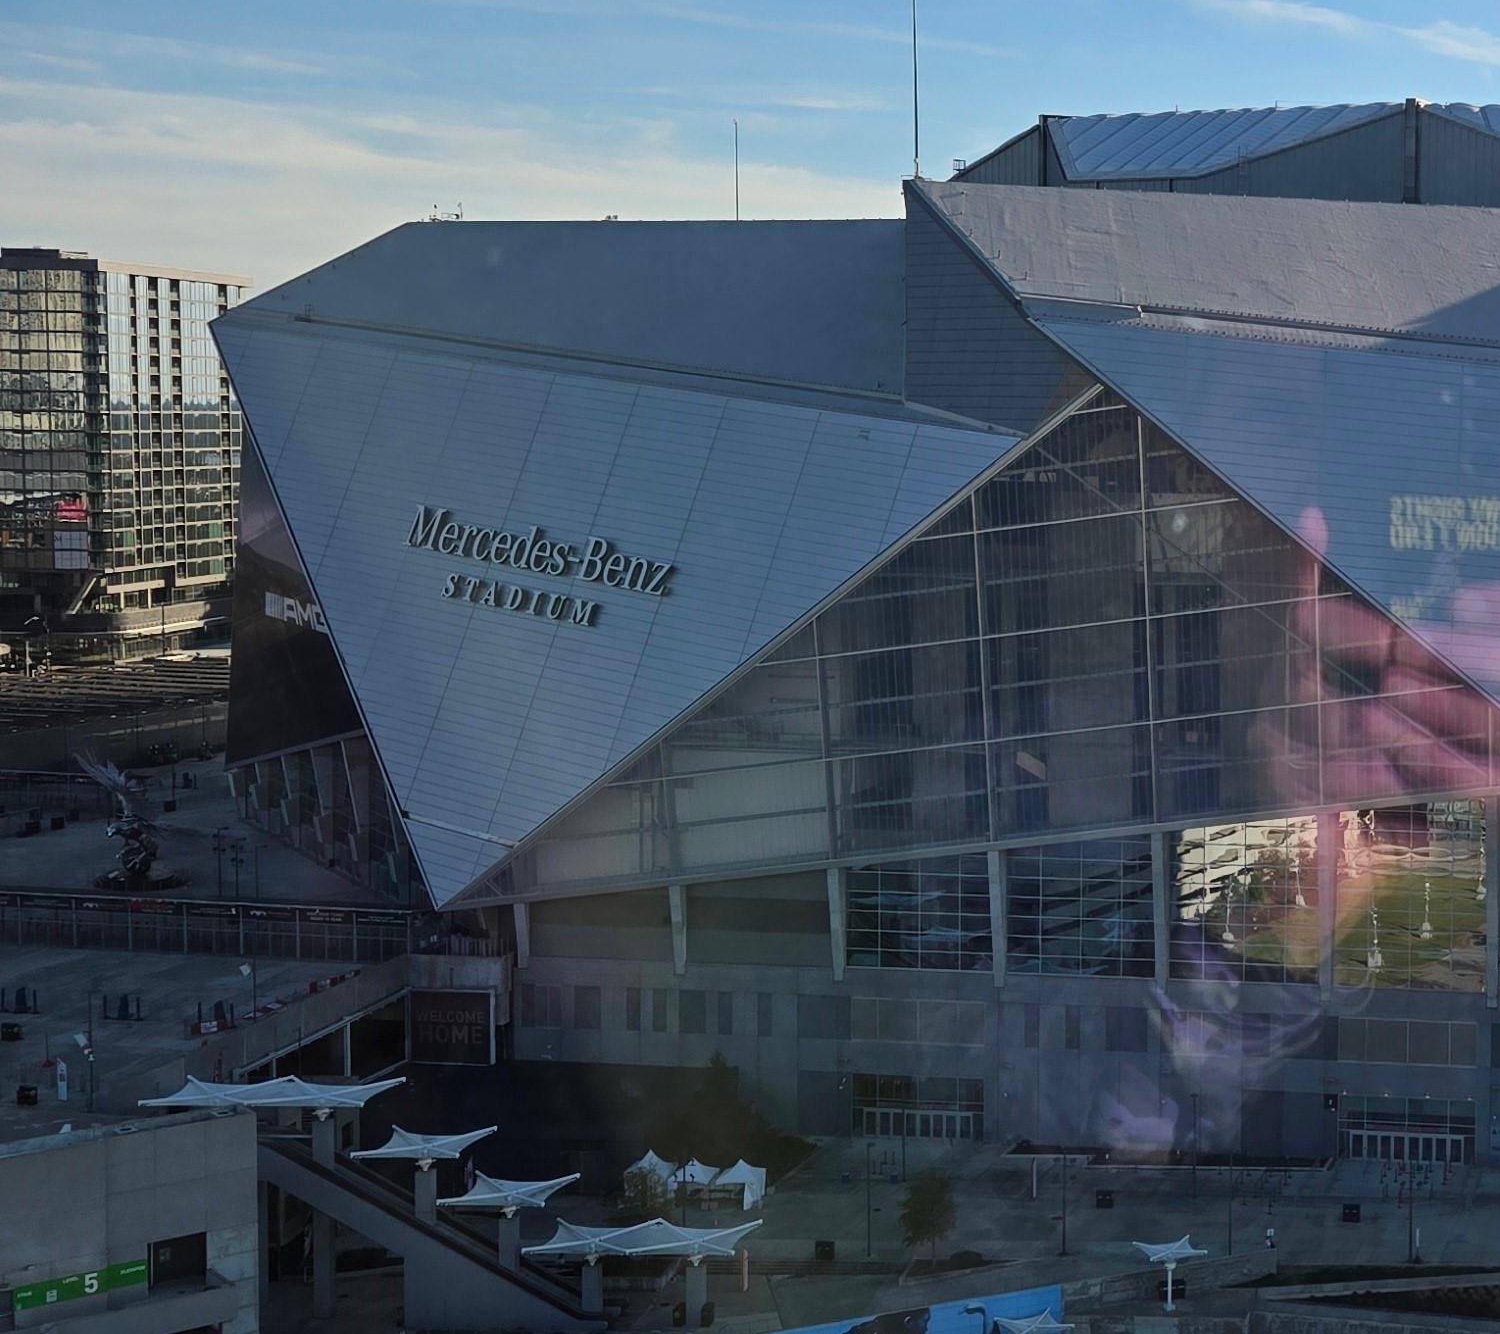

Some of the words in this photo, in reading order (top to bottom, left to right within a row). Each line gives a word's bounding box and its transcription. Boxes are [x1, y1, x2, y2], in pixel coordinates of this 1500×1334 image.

[401, 505, 674, 596] Mercedes-Benz
[440, 572, 599, 627] STADIUM
[416, 1010, 485, 1024] WELCOME
[418, 1025, 483, 1044] HOME
[84, 1272, 99, 1294] 5
